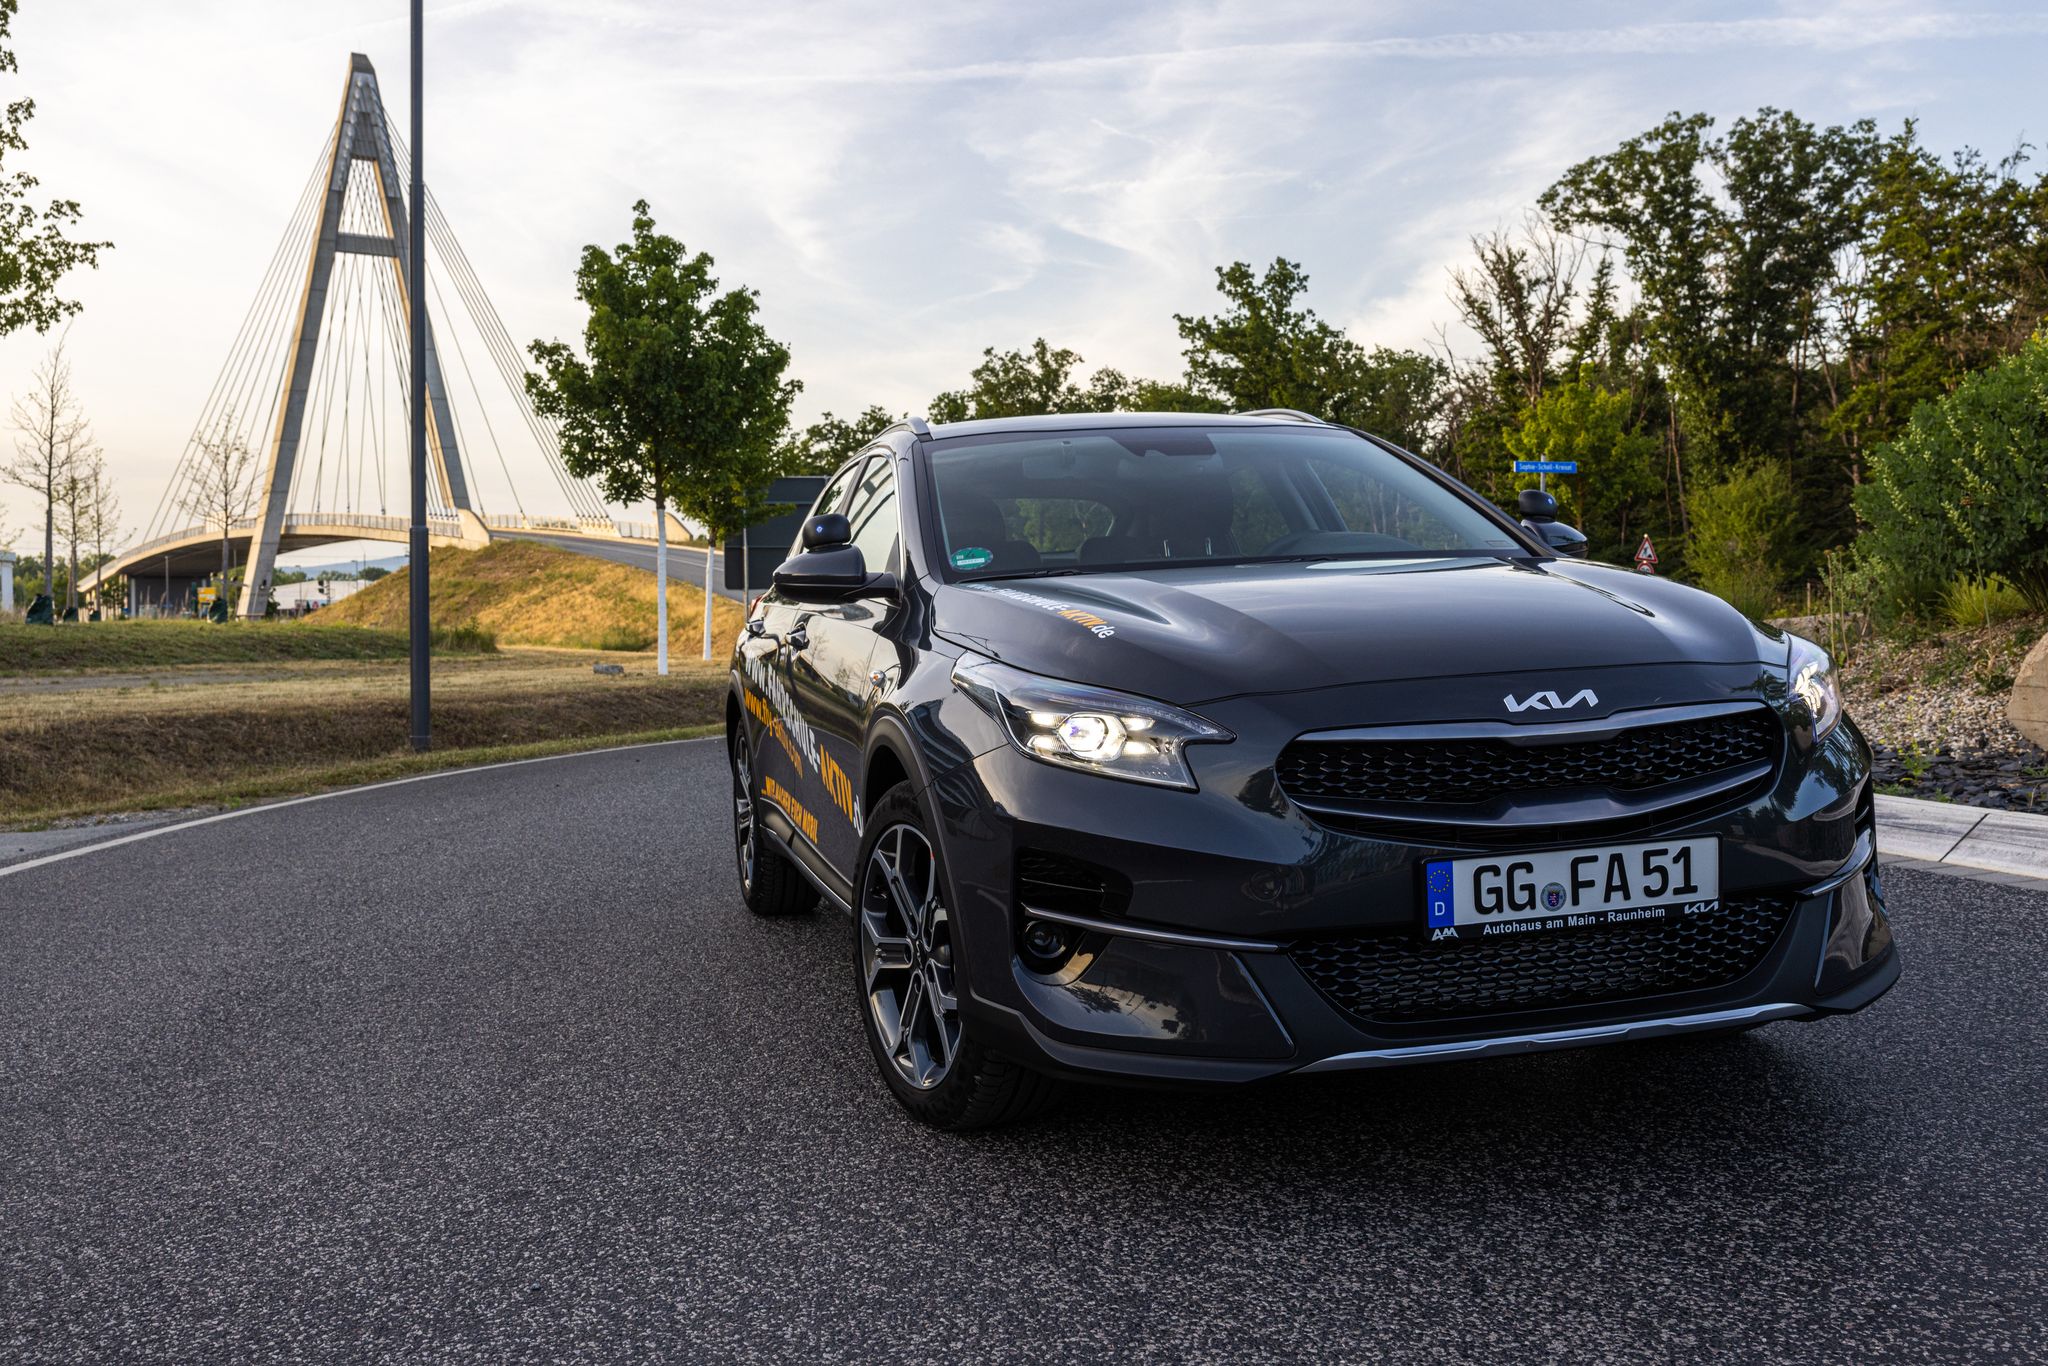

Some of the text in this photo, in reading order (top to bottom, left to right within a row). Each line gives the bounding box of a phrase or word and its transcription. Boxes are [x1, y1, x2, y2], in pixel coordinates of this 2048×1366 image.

[1503, 689, 1599, 713] KIA
[1473, 846, 1698, 915] GG FA 51
[1434, 901, 1446, 916] D
[1483, 921, 1542, 935] Autohaus
[1546, 919, 1564, 929] am
[1568, 915, 1596, 927] Main
[1608, 907, 1666, 922] Raunheim
